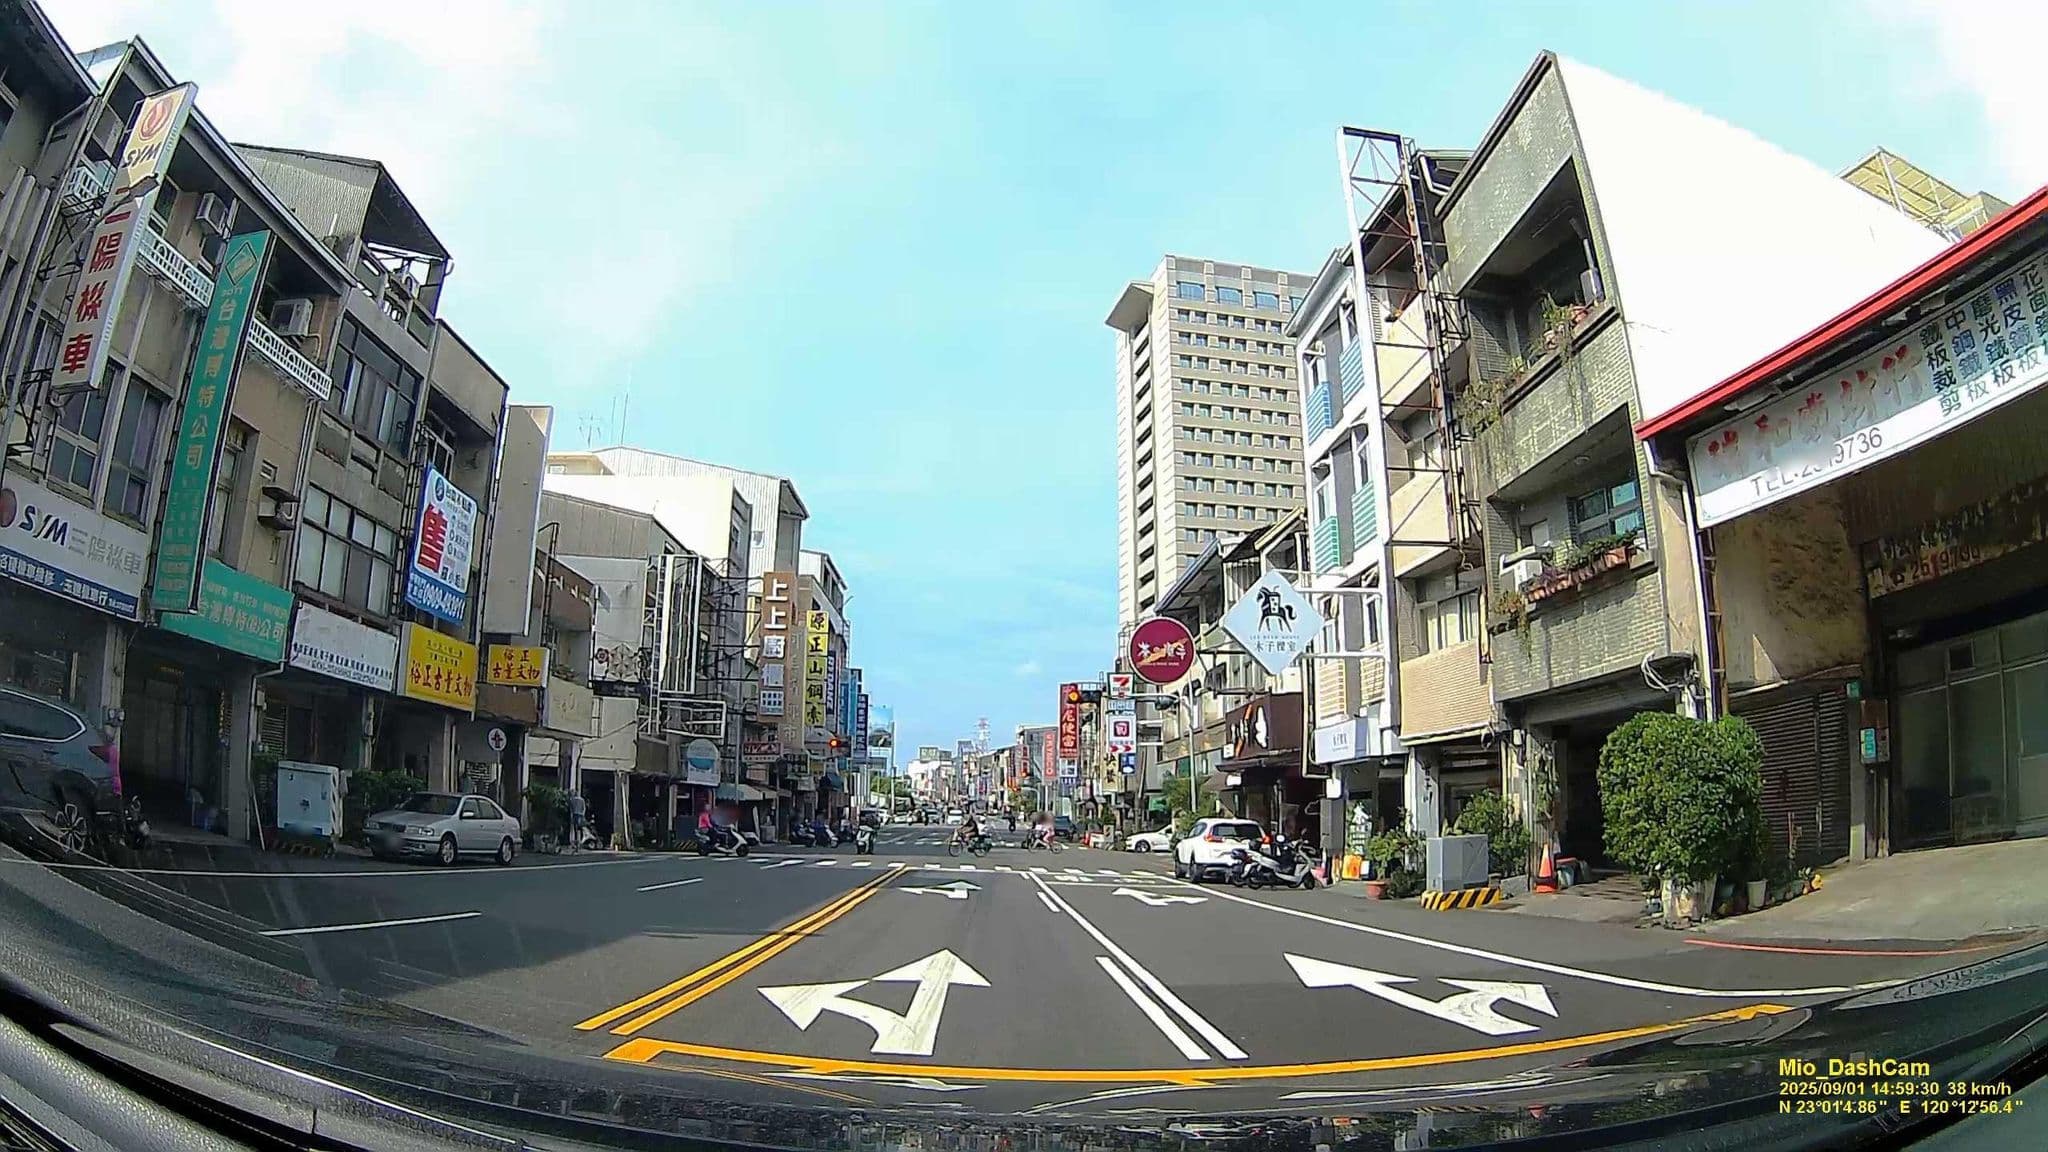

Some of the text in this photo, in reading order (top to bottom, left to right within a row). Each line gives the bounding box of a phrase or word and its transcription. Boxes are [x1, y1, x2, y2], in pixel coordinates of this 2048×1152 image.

[124, 142, 160, 168] SYM
[19, 505, 68, 546] SYM
[418, 502, 449, 573] 售
[503, 649, 530, 662] 裕正
[1137, 641, 1187, 660] 茶の手
[410, 659, 473, 698] 裕正古董文物
[492, 662, 541, 680] 古董文物
